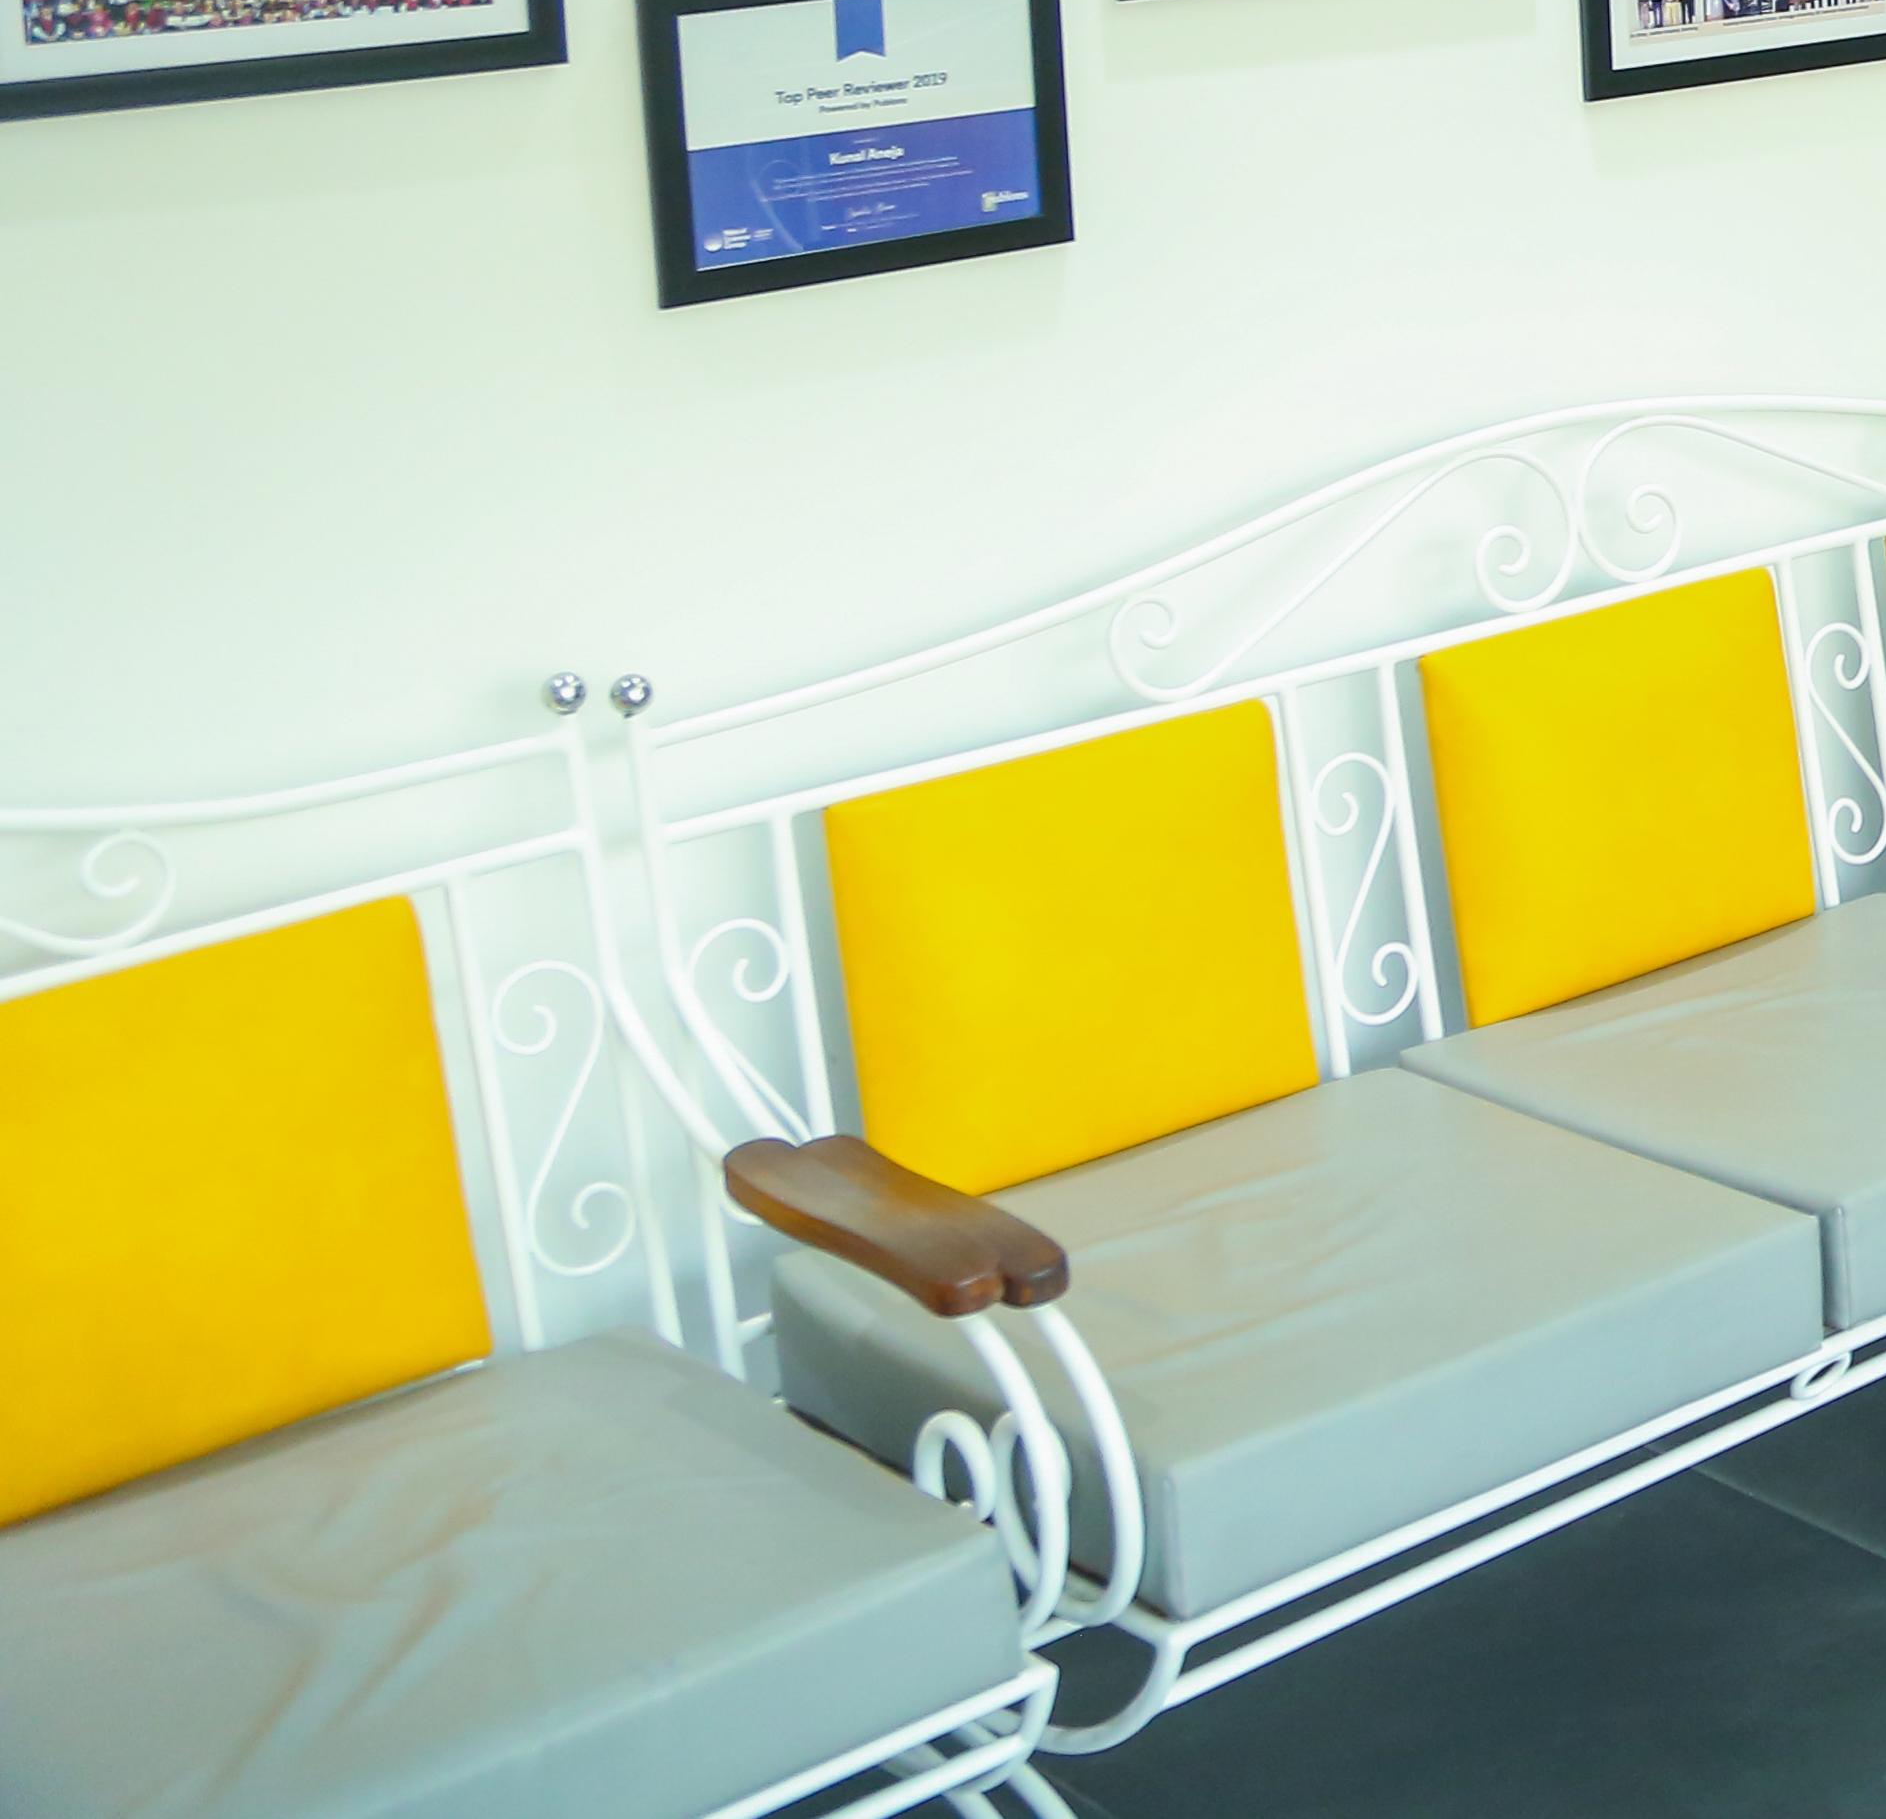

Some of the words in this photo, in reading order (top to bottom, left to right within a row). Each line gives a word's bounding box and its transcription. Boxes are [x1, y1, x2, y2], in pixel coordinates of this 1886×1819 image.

[775, 90, 803, 105] Top
[807, 87, 840, 101] Peer
[843, 80, 910, 96] Reviewer
[913, 72, 947, 88] 2019
